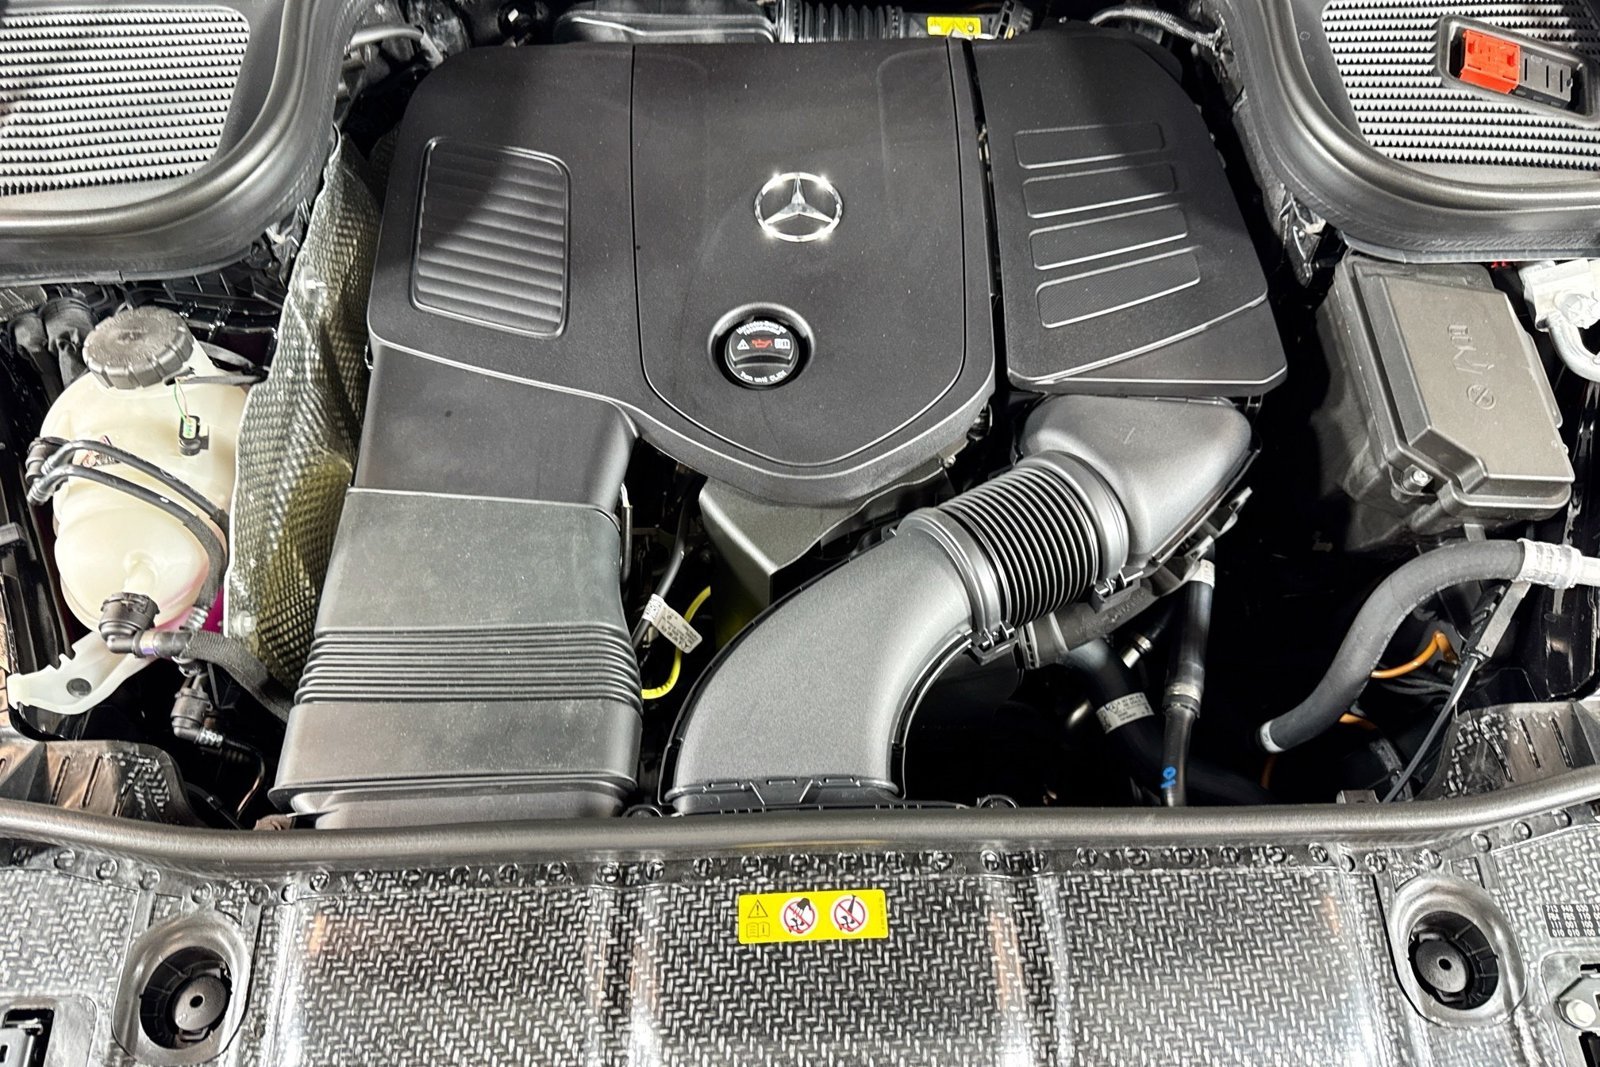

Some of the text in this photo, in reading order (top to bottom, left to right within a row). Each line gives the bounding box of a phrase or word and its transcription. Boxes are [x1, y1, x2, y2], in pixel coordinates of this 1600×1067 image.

[1579, 912, 1591, 920] 110
[1551, 920, 1594, 929] 111 001 100
[1552, 929, 1596, 937] 010 010 100
